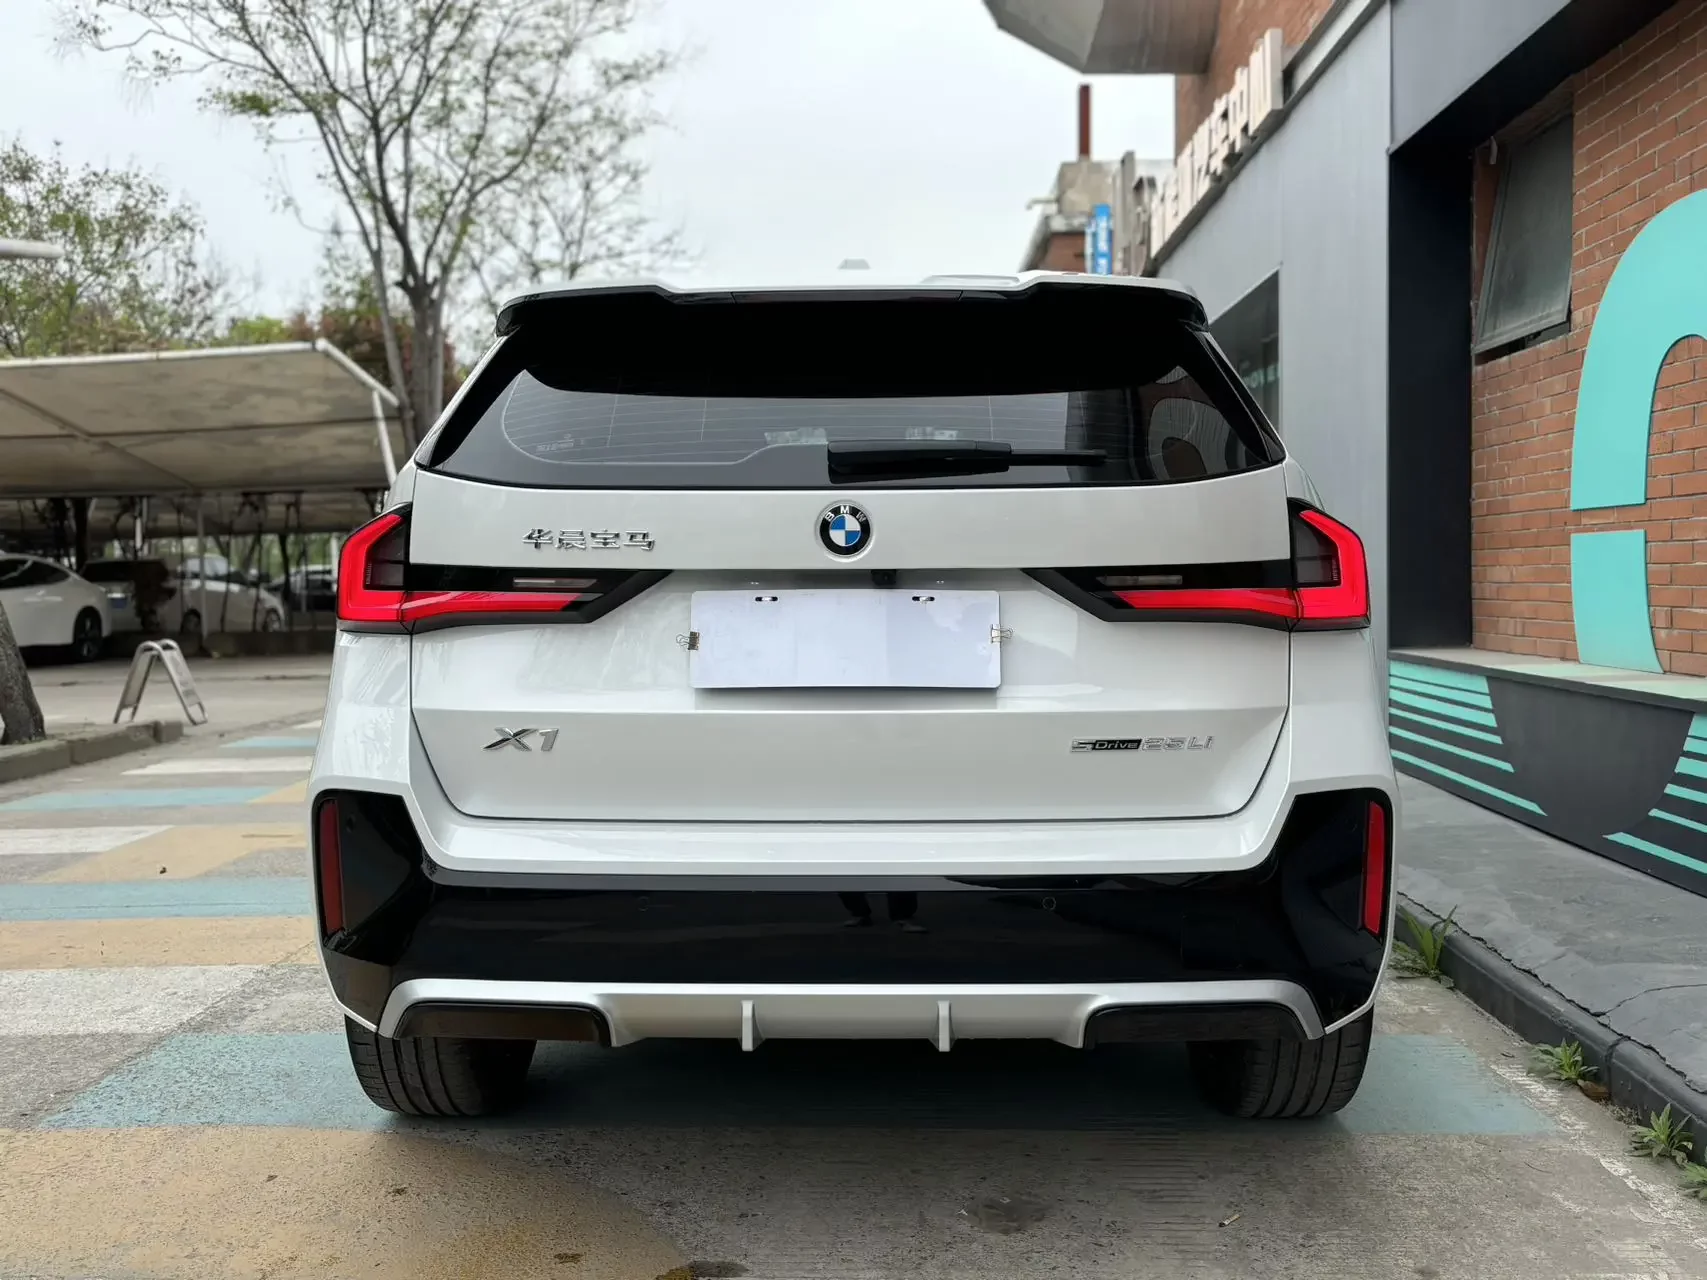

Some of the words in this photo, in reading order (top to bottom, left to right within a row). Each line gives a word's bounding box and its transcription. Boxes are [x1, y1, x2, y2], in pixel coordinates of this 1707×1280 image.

[824, 504, 868, 522] BMW
[522, 528, 655, 551] 华晨宝马
[482, 727, 560, 752] X1
